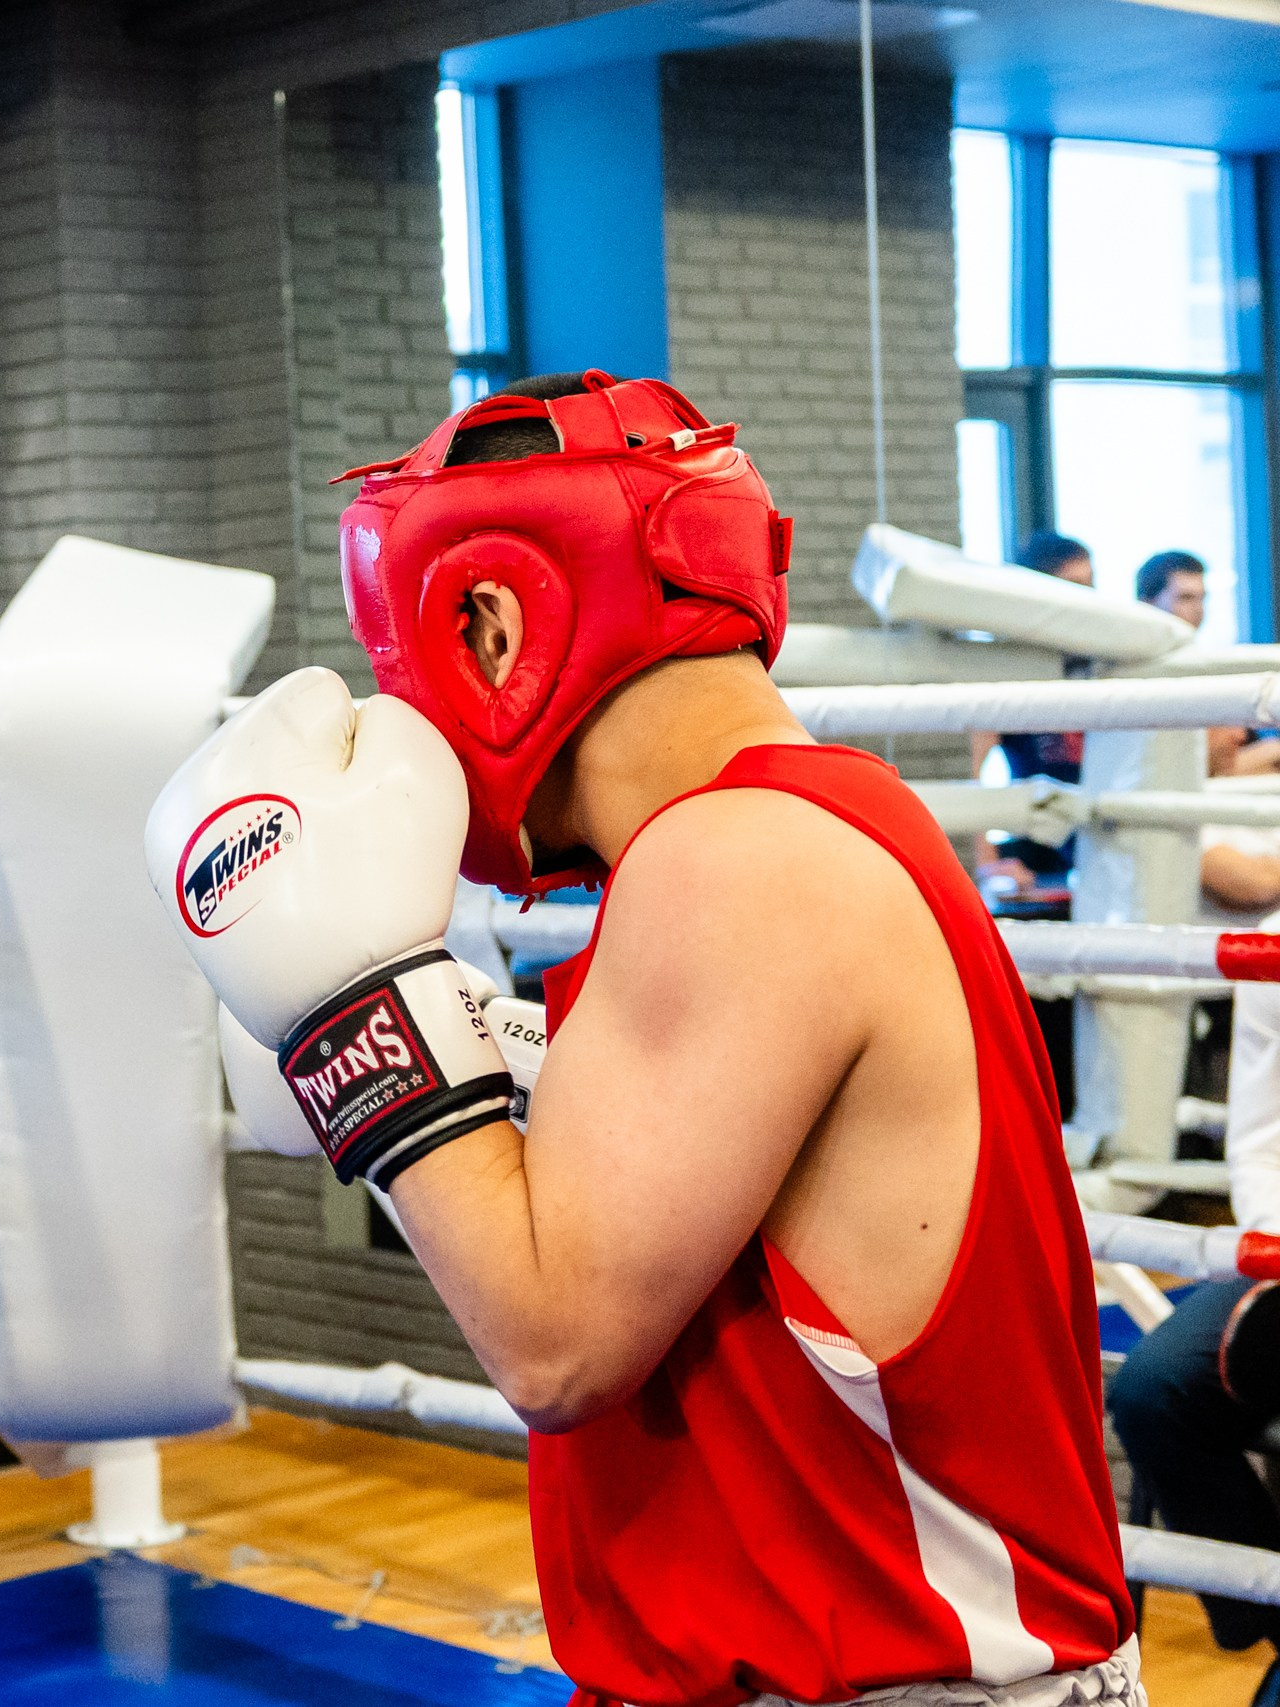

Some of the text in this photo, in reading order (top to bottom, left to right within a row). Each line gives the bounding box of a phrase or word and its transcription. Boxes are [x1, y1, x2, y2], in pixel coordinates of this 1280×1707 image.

[185, 811, 283, 928] TWINS
[199, 841, 282, 921] SPECIAL
[294, 1006, 412, 1134] TWINS
[344, 1096, 384, 1132] SPECIAL
